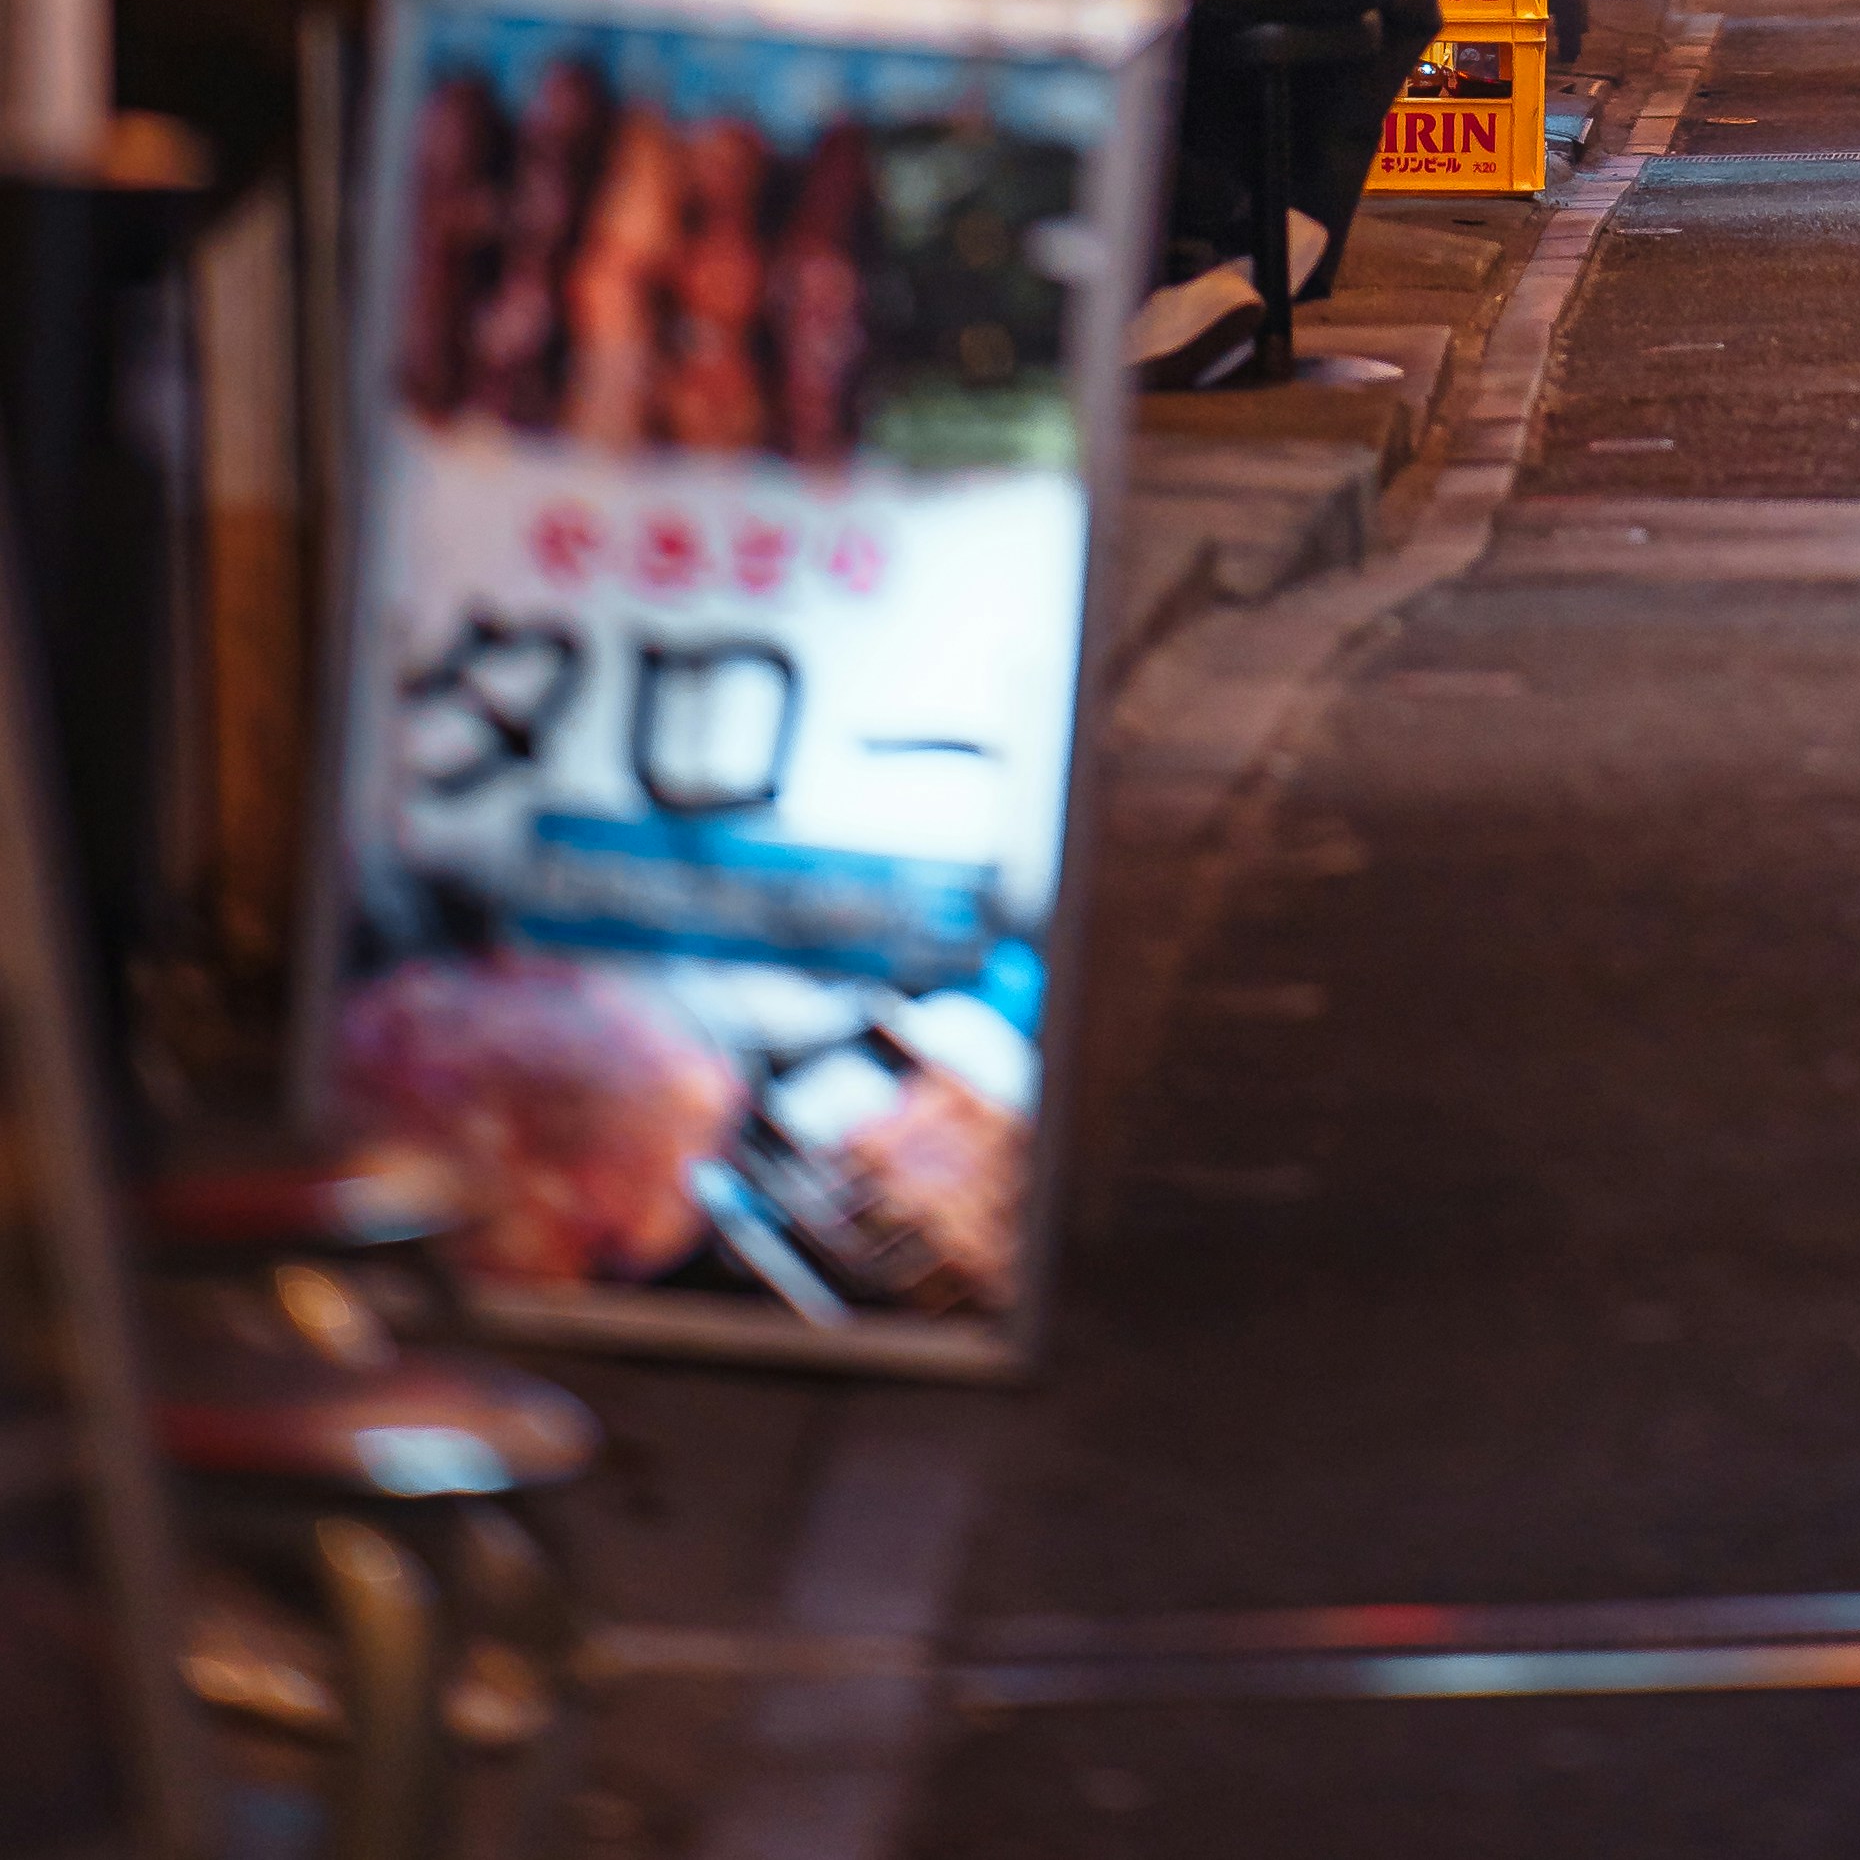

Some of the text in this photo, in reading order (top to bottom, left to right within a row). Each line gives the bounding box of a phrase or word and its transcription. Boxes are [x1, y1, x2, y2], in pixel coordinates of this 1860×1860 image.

[1380, 112, 1498, 154] IRIN
[1381, 156, 1462, 174] キリンビール
[400, 599, 992, 813] タロー
